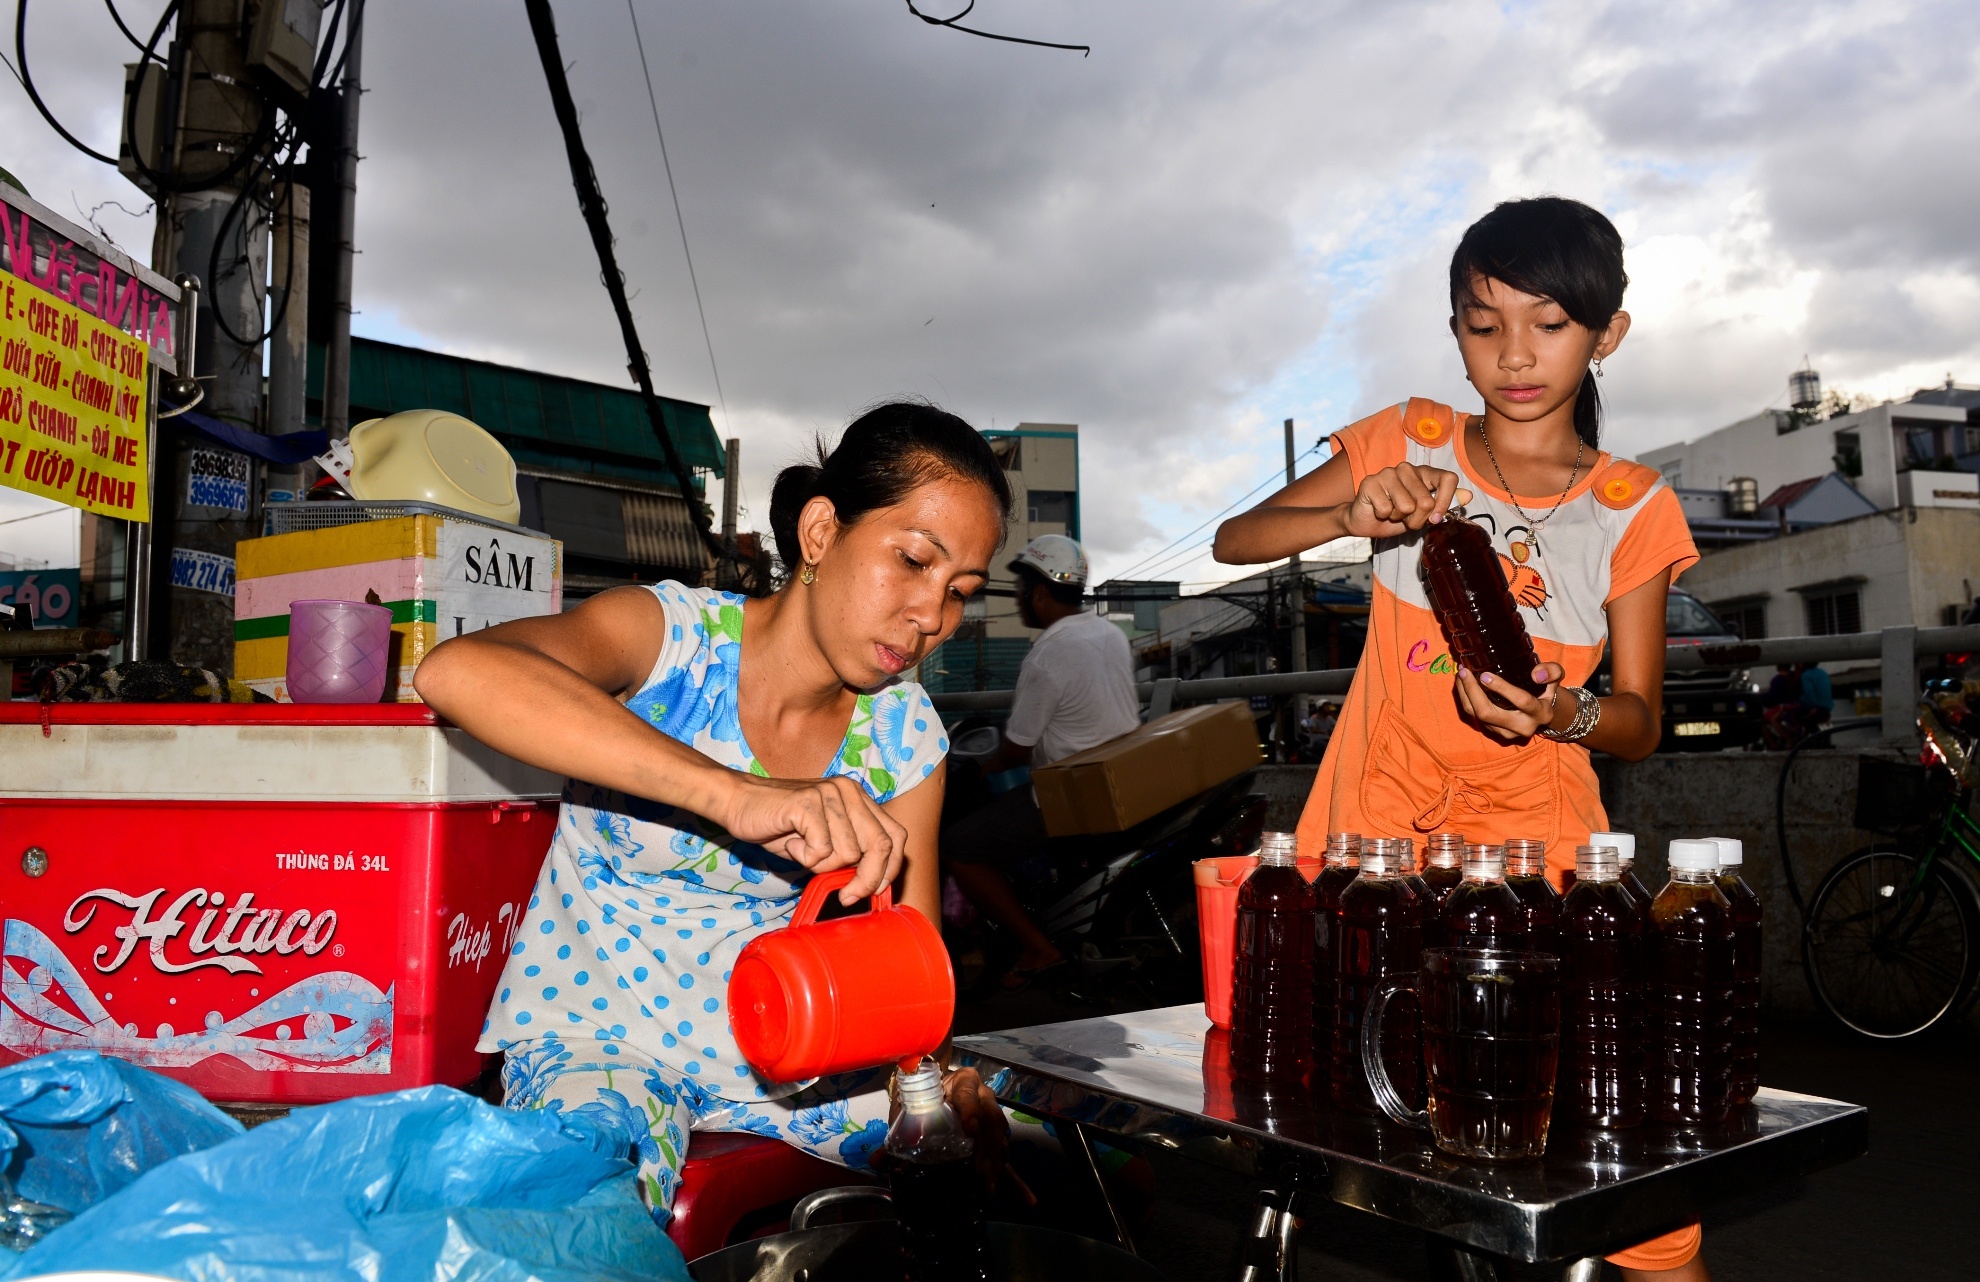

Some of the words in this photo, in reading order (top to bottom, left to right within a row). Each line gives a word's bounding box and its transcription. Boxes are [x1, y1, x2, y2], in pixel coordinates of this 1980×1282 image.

[28, 297, 59, 342] CAFE
[61, 313, 79, 351] ĐÁ
[90, 328, 118, 370] CAFE
[119, 341, 143, 382] SỮA
[32, 350, 62, 391] SỮA
[71, 369, 114, 413] CHANH
[28, 400, 78, 446] CHANH
[91, 423, 110, 459] ĐÁ
[112, 435, 138, 467] ME
[24, 448, 75, 490] ƯỚP
[76, 467, 136, 510] LẠNH
[190, 481, 247, 511] 39696873
[196, 562, 219, 591] 274
[465, 538, 535, 592] SÂM
[276, 849, 329, 870] THÙNG
[333, 850, 355, 871] ĐÁ
[361, 855, 390, 872] 34L
[64, 888, 337, 976] Hitaco
